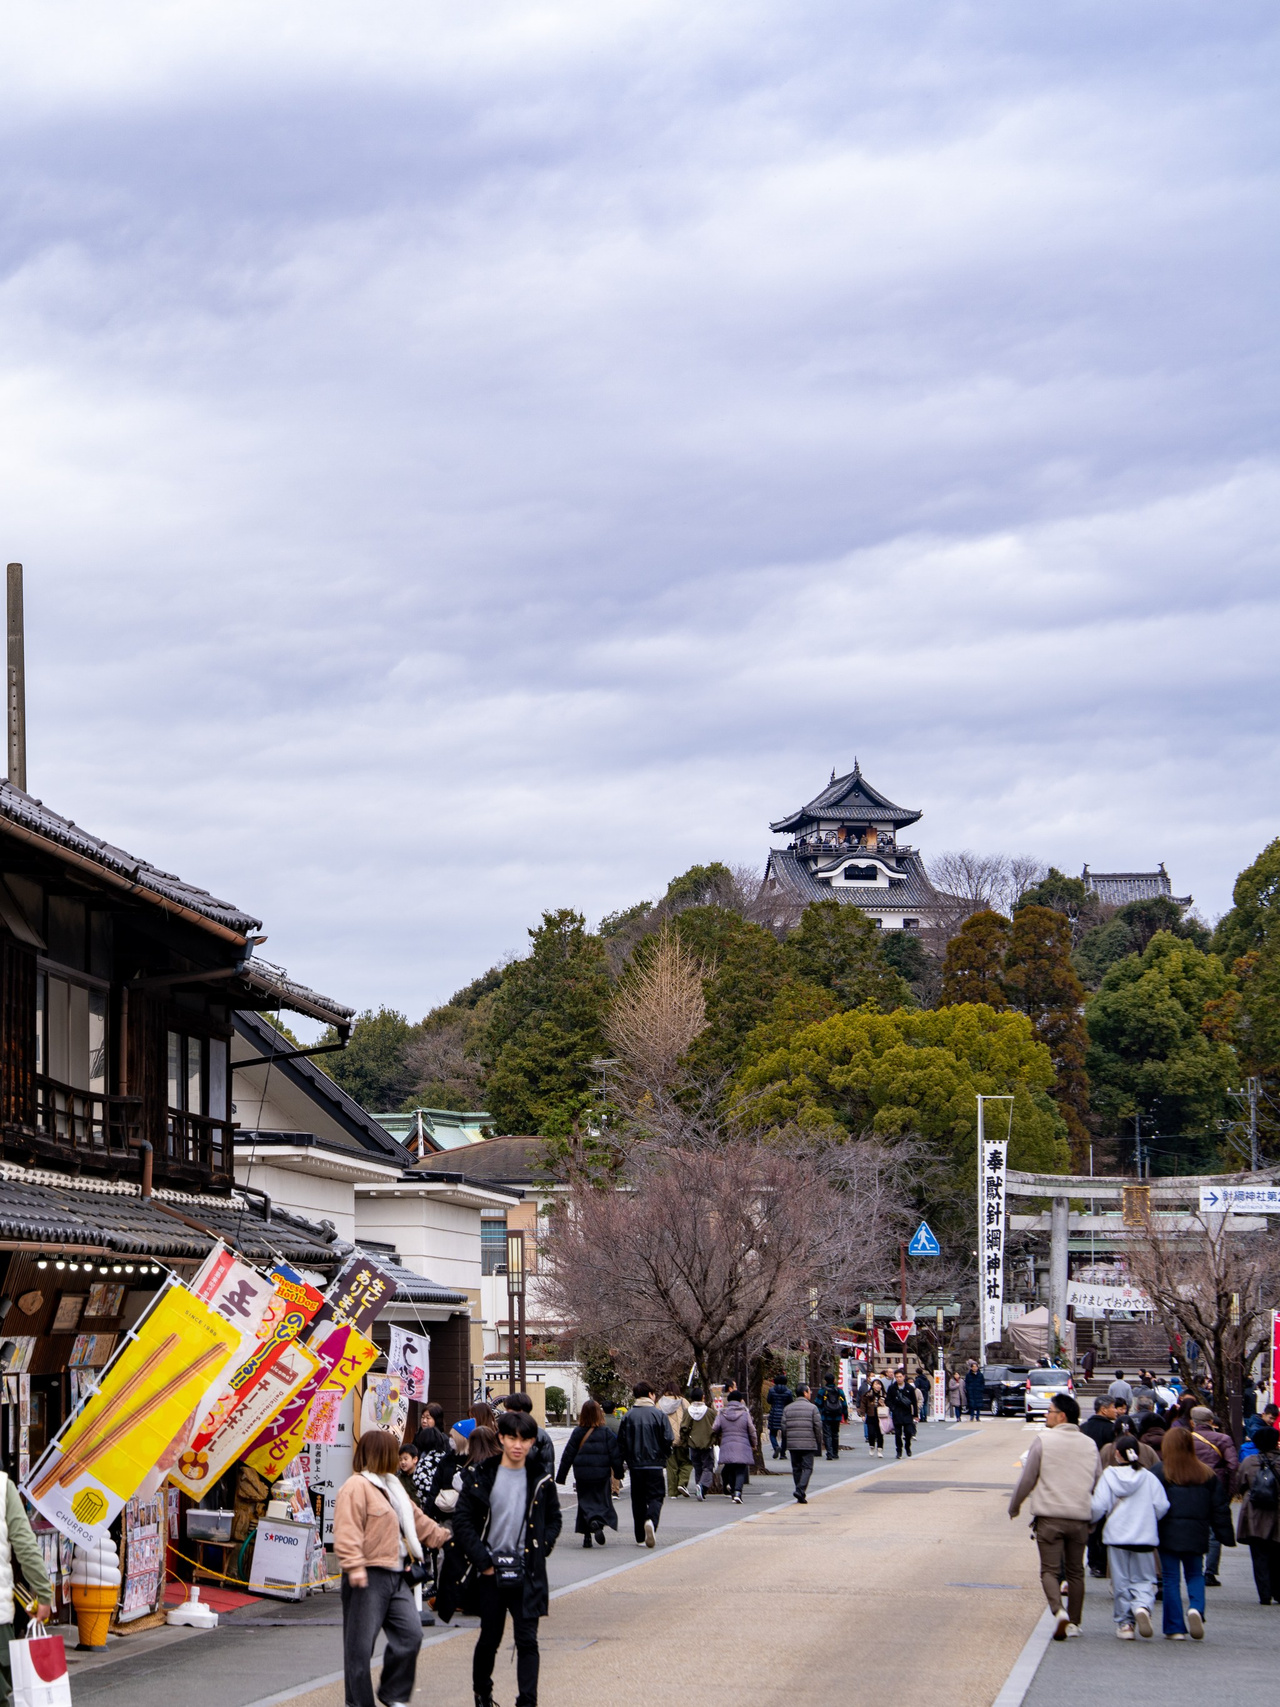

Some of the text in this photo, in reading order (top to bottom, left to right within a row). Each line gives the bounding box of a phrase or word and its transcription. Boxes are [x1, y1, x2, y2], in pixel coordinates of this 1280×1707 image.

[1222, 1190, 1280, 1202] 針綱神社第
[270, 1272, 307, 1296] Cheese
[276, 1283, 320, 1312] Hot Dog
[185, 1309, 202, 1325] SINCE
[267, 1352, 335, 1435] チップス
[269, 1354, 362, 1460] さついも
[205, 1379, 271, 1453] チーズボール
[55, 1510, 94, 1542] CHURROS
